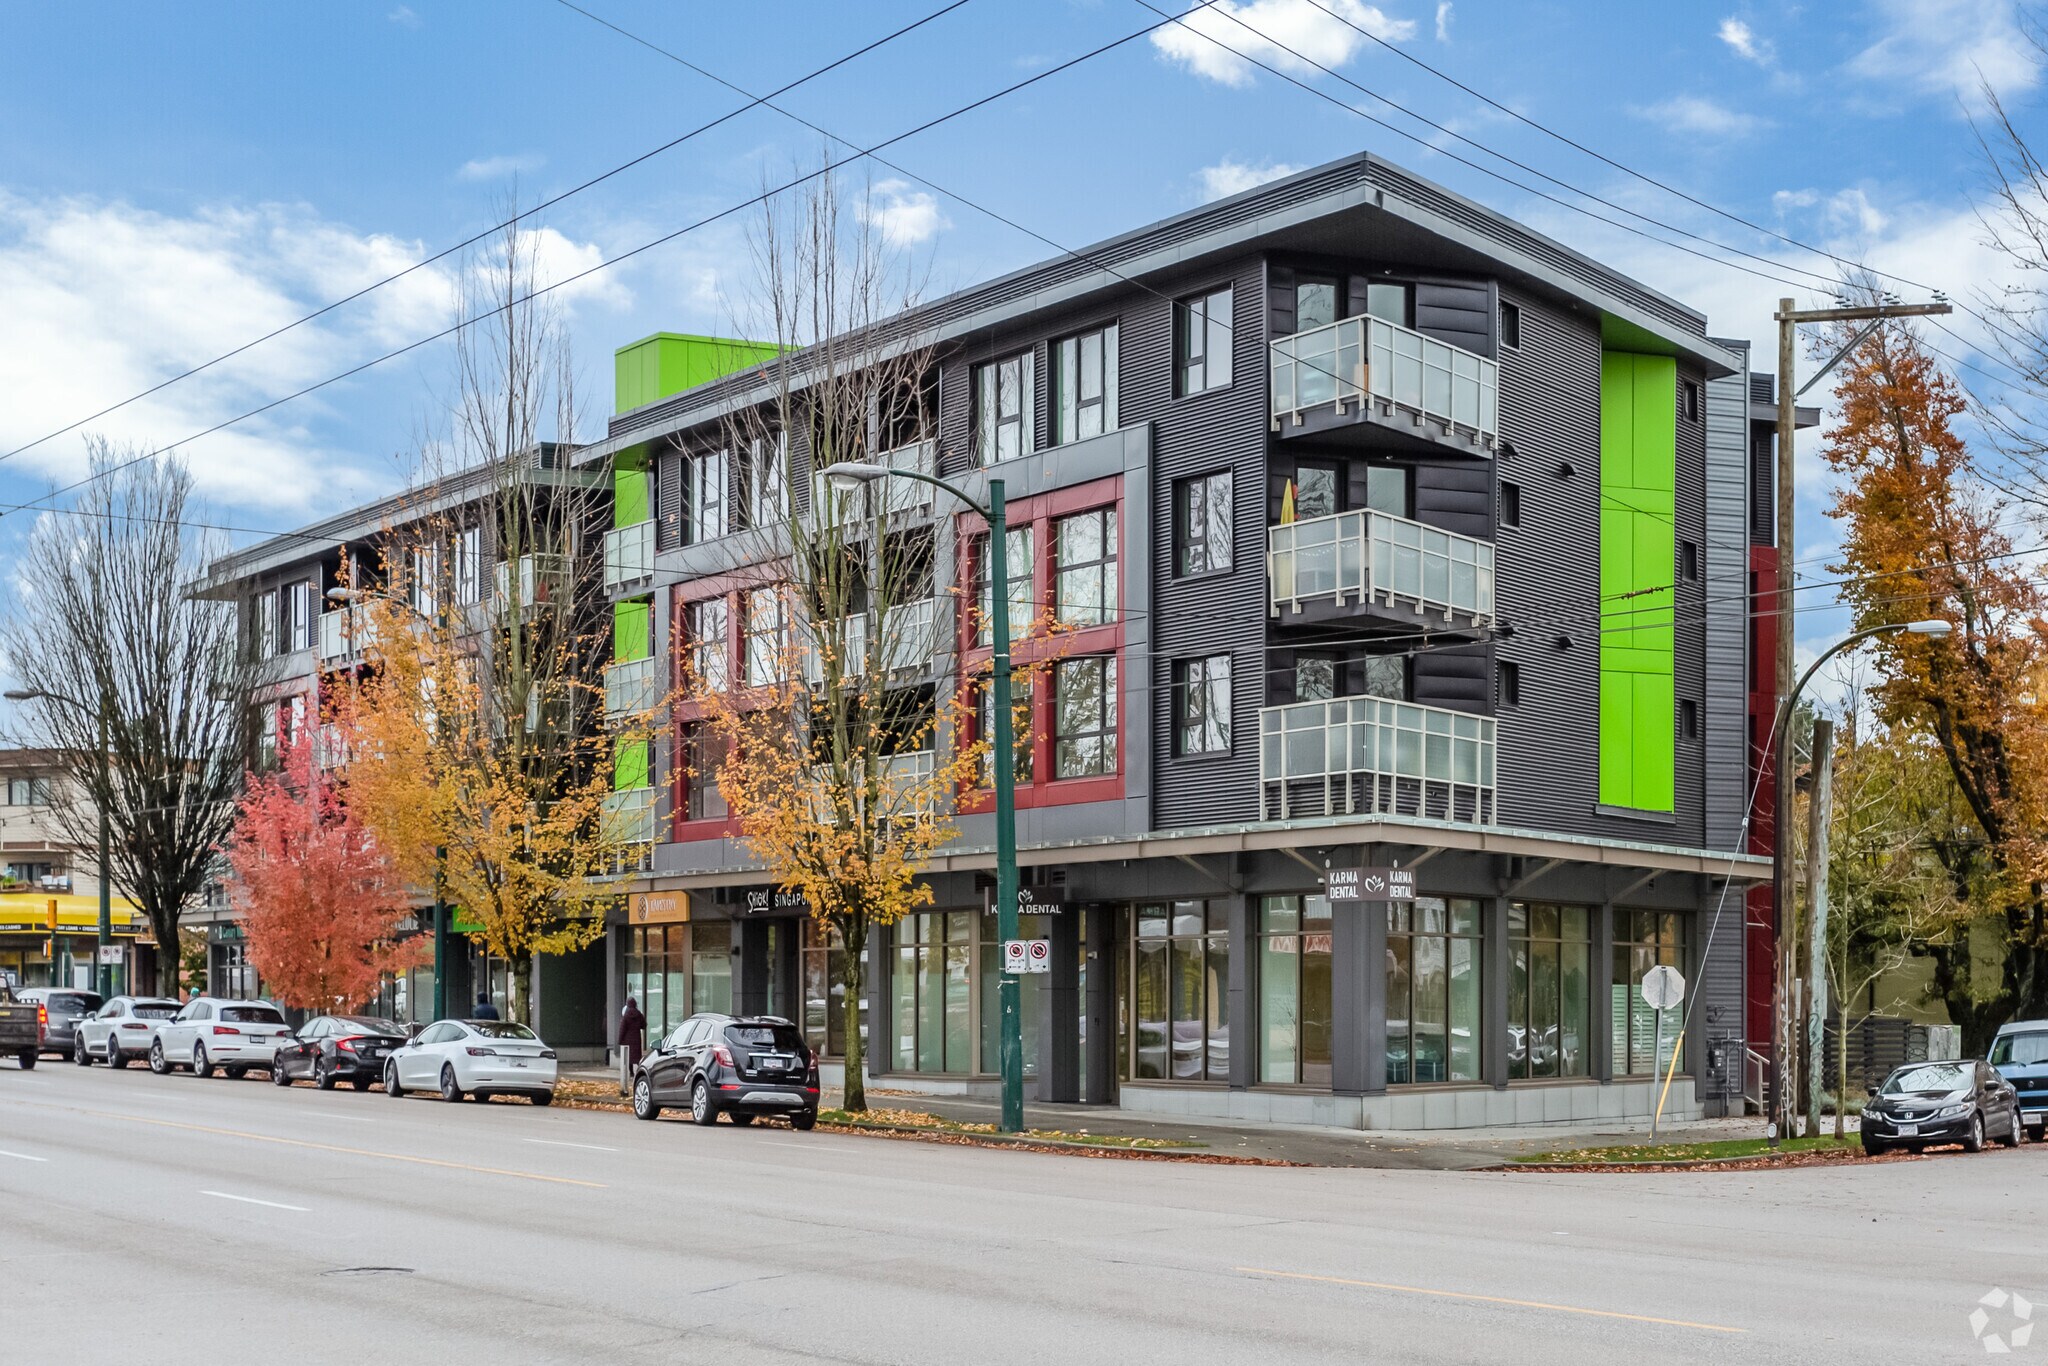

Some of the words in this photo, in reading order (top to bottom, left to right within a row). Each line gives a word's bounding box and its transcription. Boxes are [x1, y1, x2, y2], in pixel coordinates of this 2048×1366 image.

[1329, 870, 1358, 885] KARMA
[1389, 870, 1413, 884] KARMA
[1329, 885, 1359, 899] DENTAL
[1389, 885, 1413, 899] DENTAL
[1026, 904, 1062, 914] DENTAL
